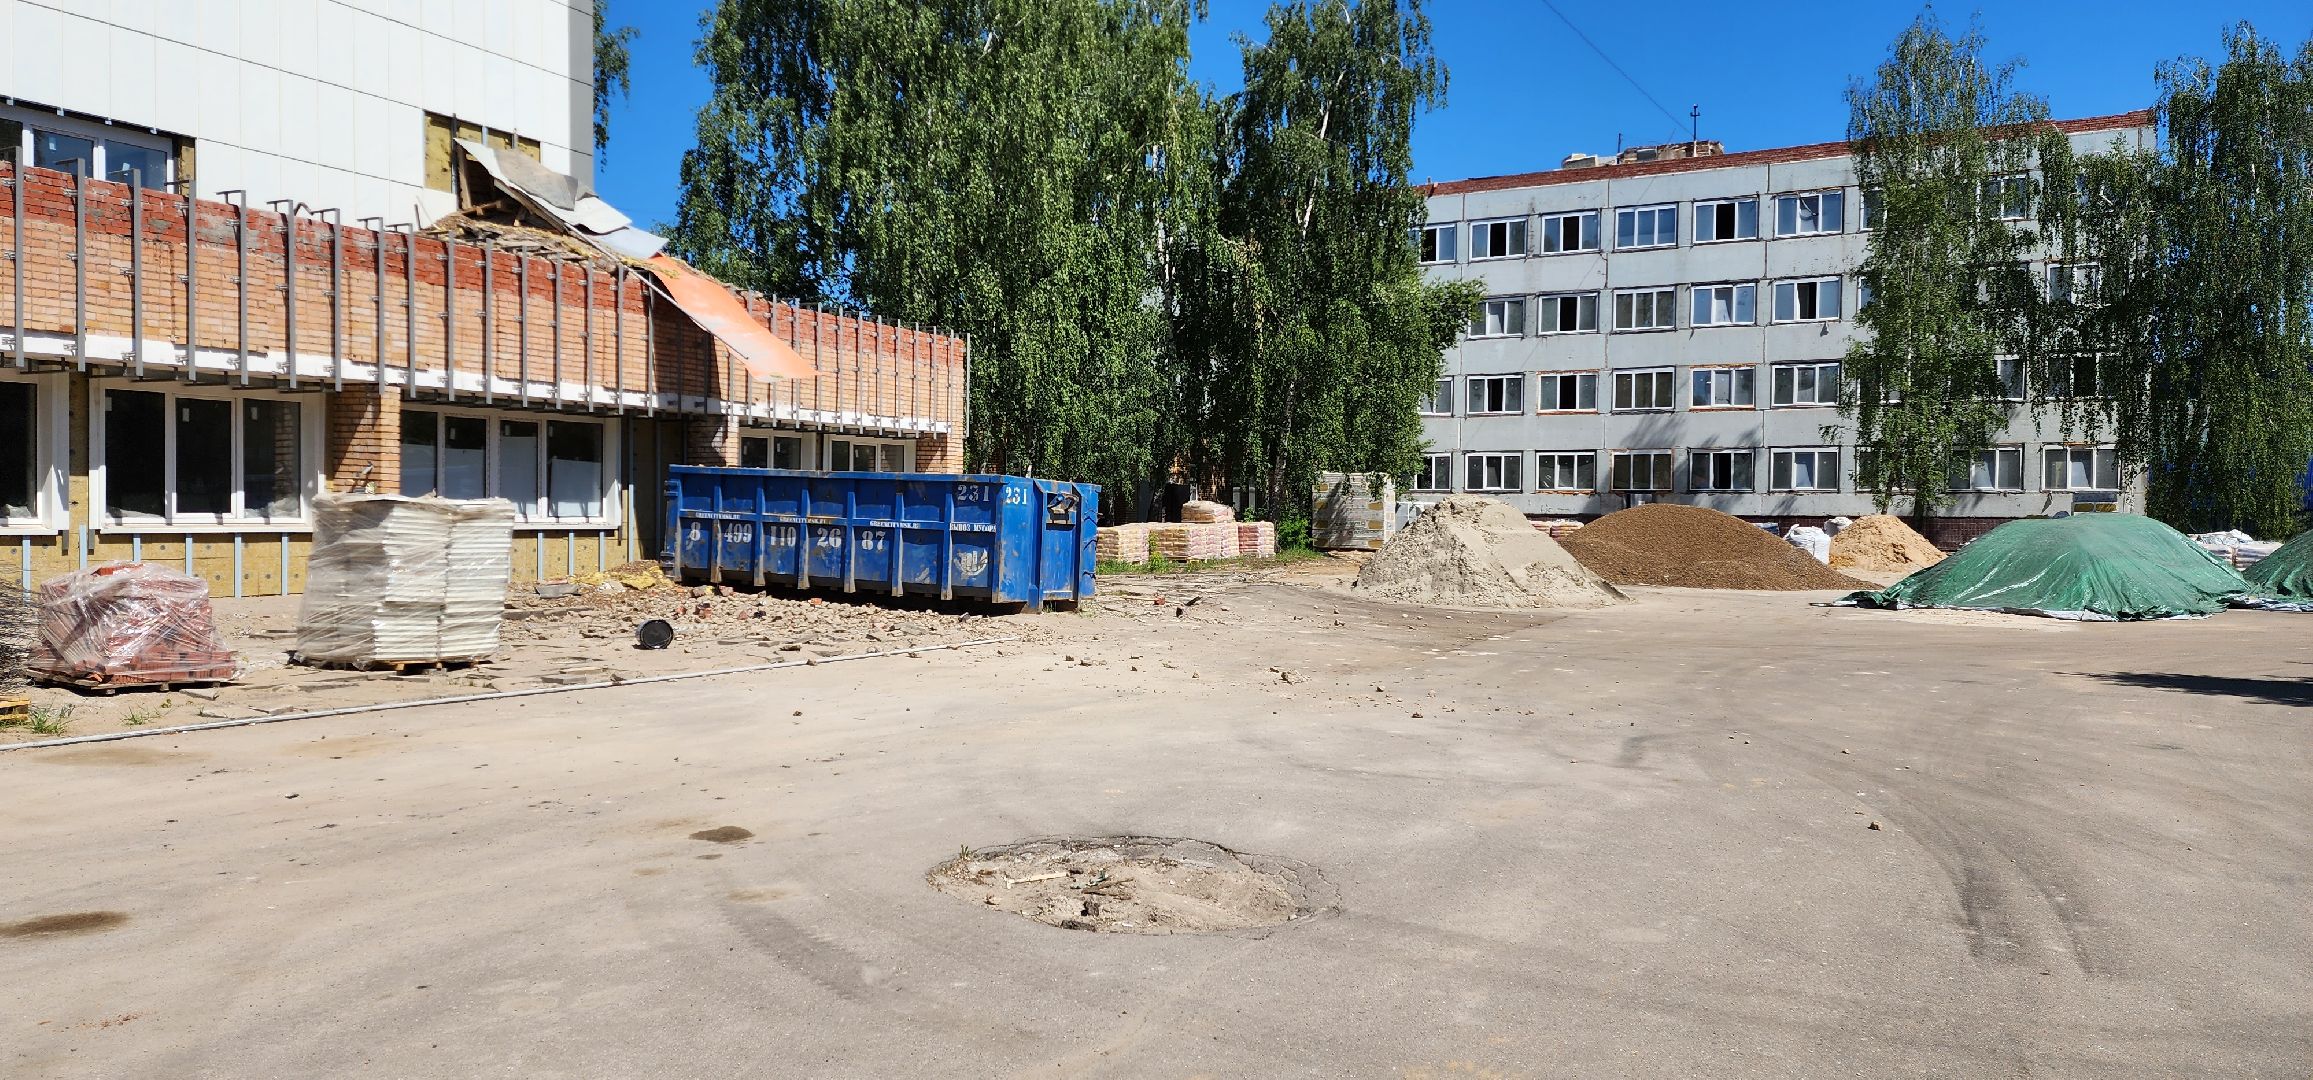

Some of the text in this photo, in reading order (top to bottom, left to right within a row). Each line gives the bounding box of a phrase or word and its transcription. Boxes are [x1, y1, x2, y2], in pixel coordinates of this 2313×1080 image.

[957, 484, 990, 502] 231
[1005, 486, 1027, 505] 231
[690, 521, 886, 551] 8 499 110 26 87
